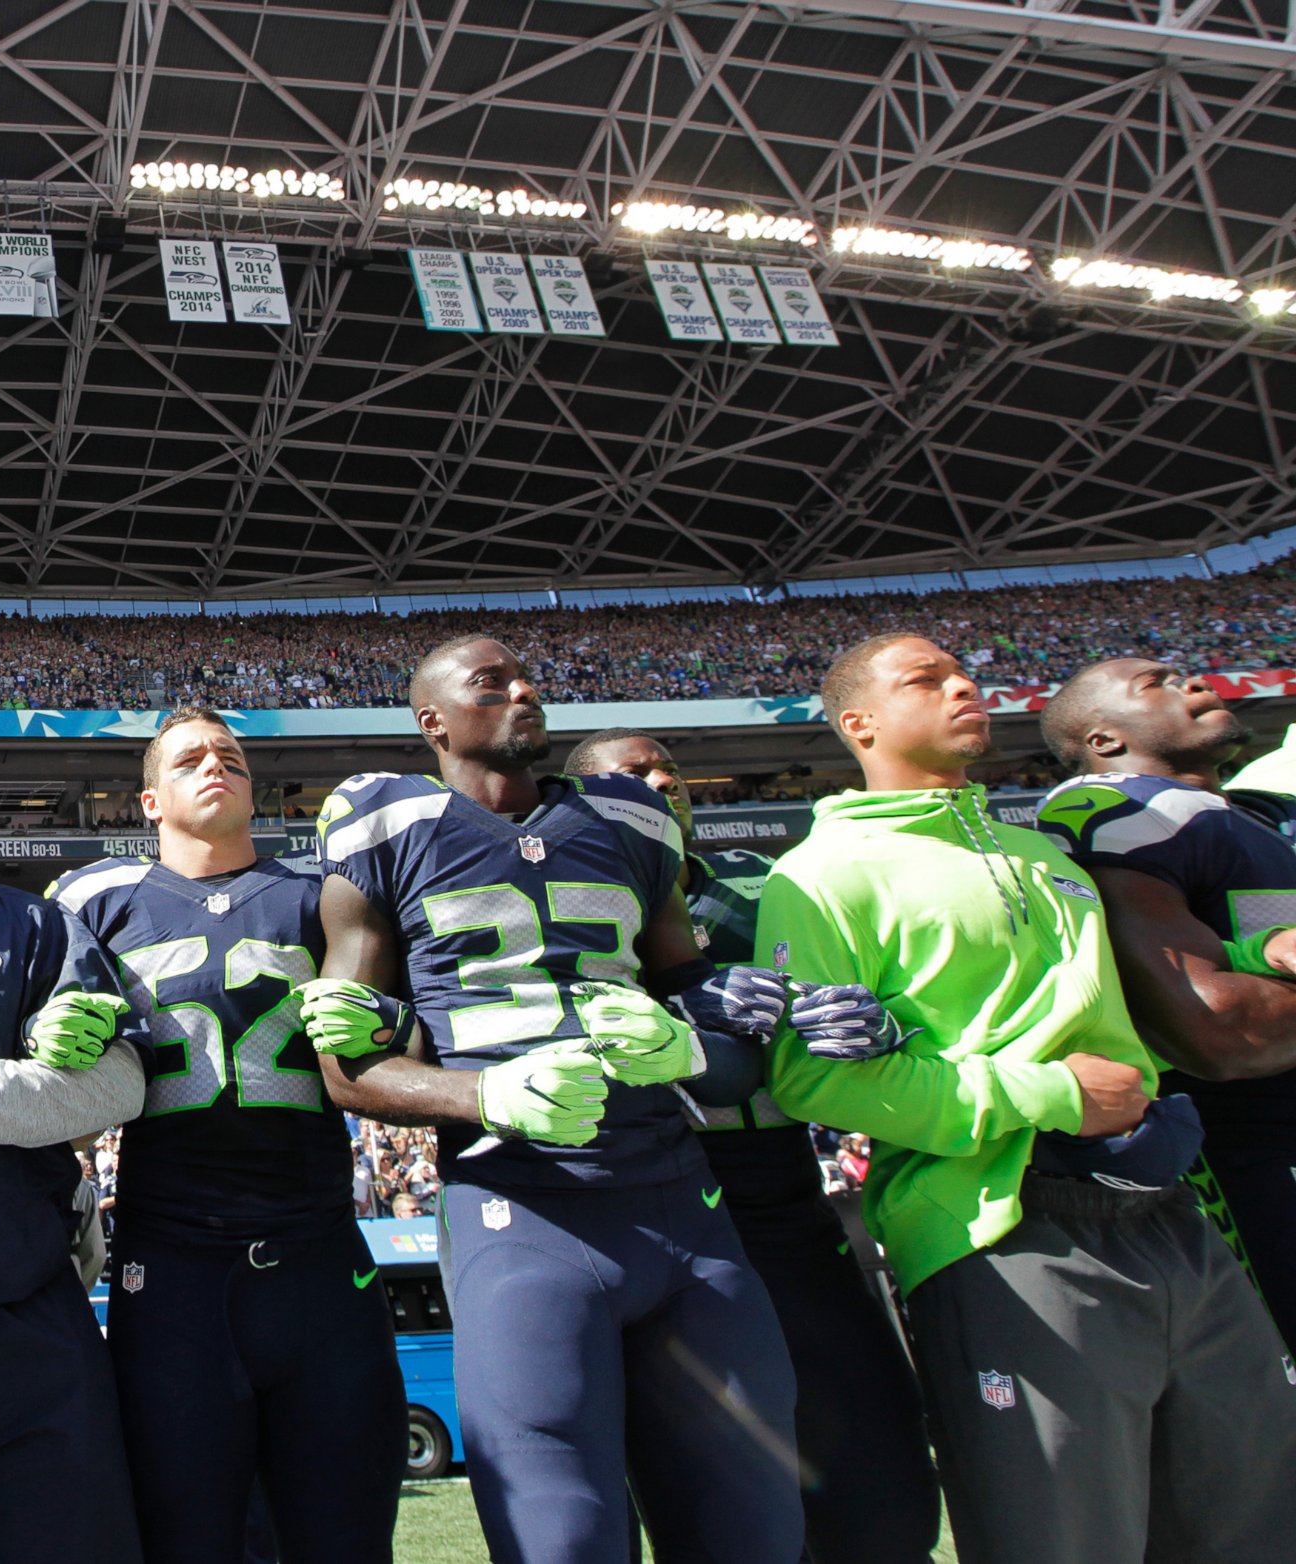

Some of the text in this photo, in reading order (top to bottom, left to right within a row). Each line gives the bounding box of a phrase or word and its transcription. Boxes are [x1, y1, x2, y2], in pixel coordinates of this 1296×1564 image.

[5, 236, 48, 247] WORLD
[174, 245, 201, 255] NFC
[172, 255, 206, 266] WEST
[419, 253, 453, 261] LEAGUE
[485, 256, 509, 266] U.S.
[235, 261, 272, 274] 2014
[420, 260, 458, 268] CHAMPS
[544, 259, 568, 269] U.S.
[660, 264, 685, 274] U.S.
[475, 266, 525, 276] OPEN CUP
[535, 269, 584, 278] OPEN CUP
[242, 274, 269, 285] NFC
[652, 274, 700, 283] OPEN CUP
[737, 278, 757, 287] CUP
[231, 284, 284, 295] CHAMPIONS
[434, 290, 459, 299] 1995
[168, 290, 221, 302] CHAMPS
[180, 301, 213, 312] 2014
[437, 300, 461, 308] 1996
[439, 309, 463, 317] 2005
[487, 307, 538, 319] CHAMPS
[548, 310, 598, 321] CHAMPS
[441, 318, 465, 326] 2007
[501, 318, 529, 328] 2009
[563, 320, 590, 330] 2010
[667, 314, 715, 326] CHAMPS
[725, 317, 774, 329] CHAMPS
[782, 320, 832, 331] CHAMPS
[695, 821, 754, 840] KENNEDY
[31, 843, 62, 857] 80-91
[103, 840, 161, 856] 45 KENN
[421, 881, 648, 1050] 33
[116, 935, 323, 1118] 52
[126, 1275, 141, 1288] NFL
[985, 1386, 1010, 1403] NFL
